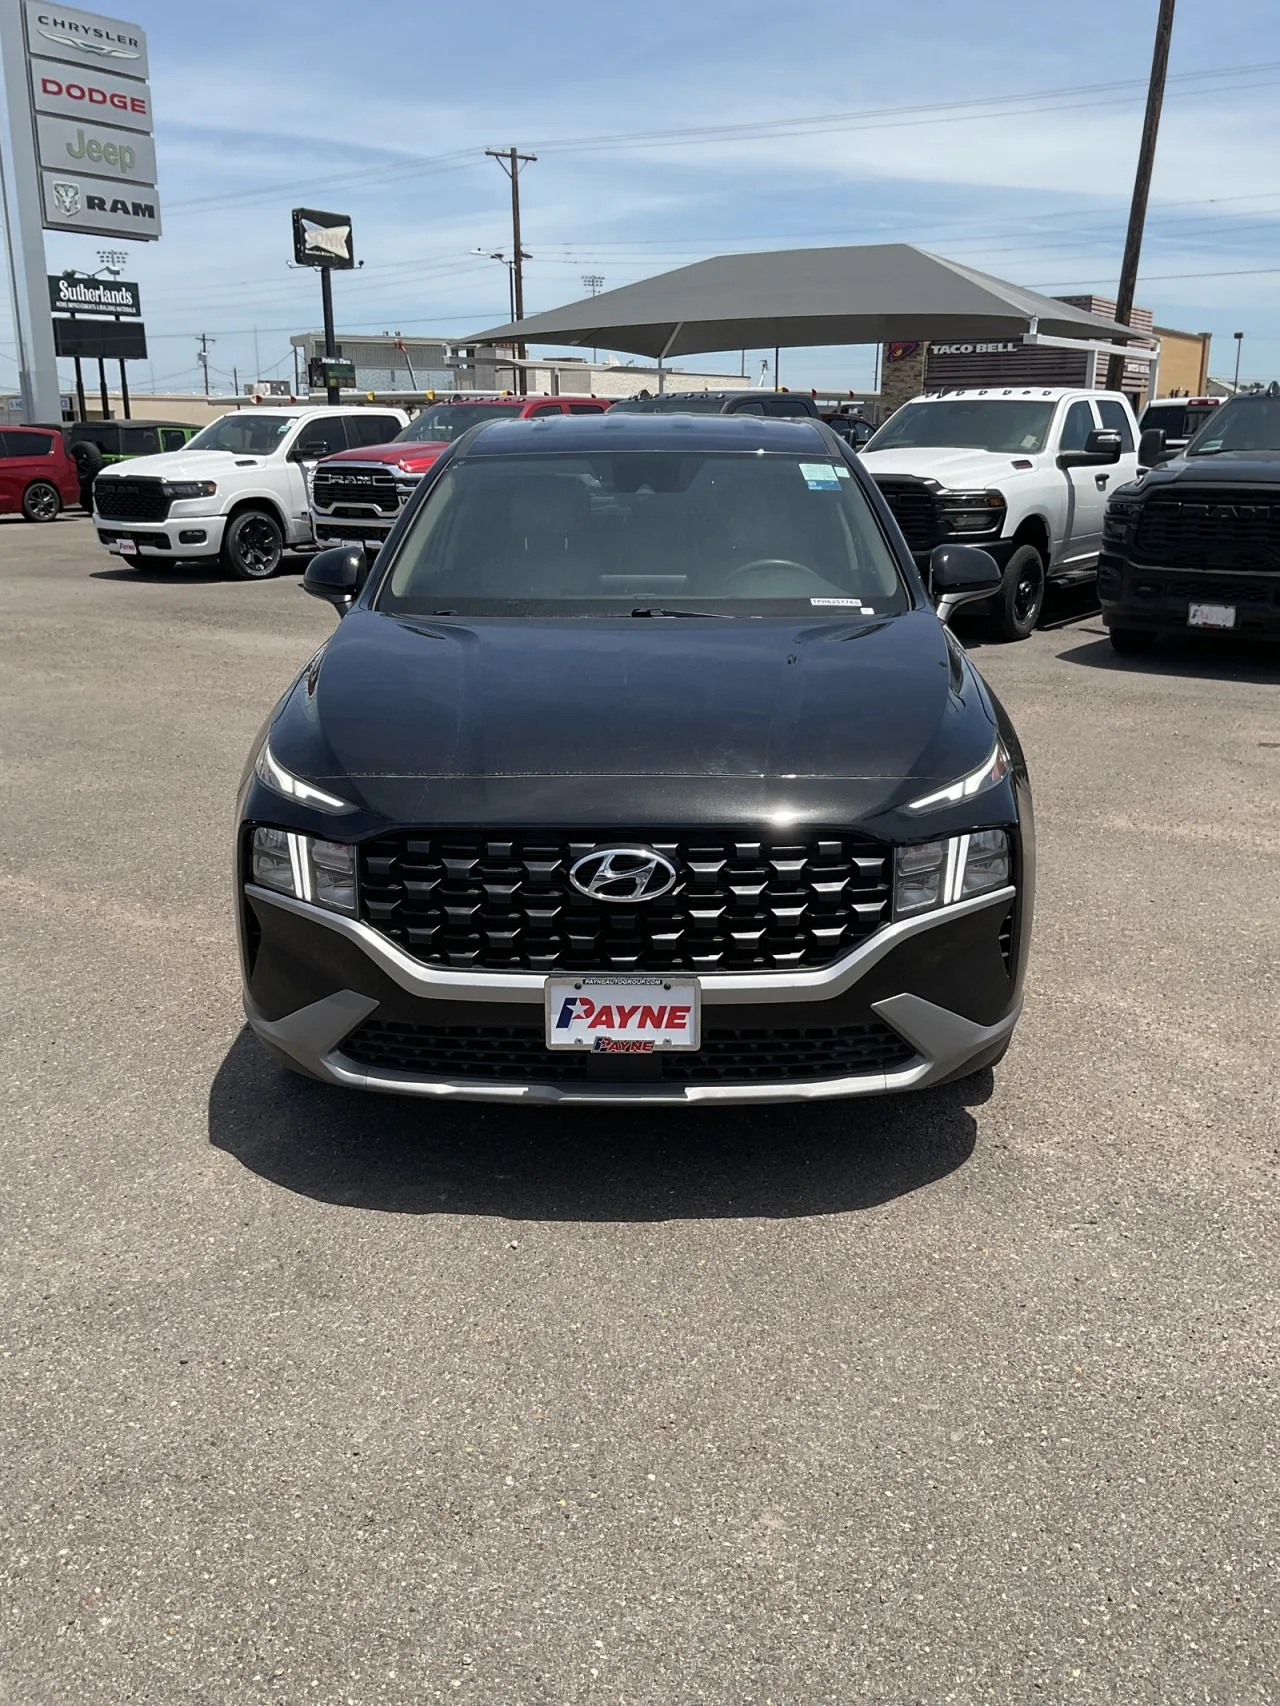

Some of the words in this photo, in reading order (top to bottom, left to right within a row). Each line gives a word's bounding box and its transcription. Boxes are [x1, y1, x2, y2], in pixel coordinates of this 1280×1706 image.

[37, 15, 139, 47] CHRYSLER
[41, 78, 146, 114] DODGE
[66, 128, 136, 174] Jeep
[86, 194, 155, 219] RAM
[59, 280, 133, 305] Sutherlands
[931, 344, 971, 354] TACO
[975, 343, 1018, 353] BELL
[332, 475, 371, 484] RAM
[555, 997, 692, 1029] PAYNE
[594, 1036, 655, 1052] PAYNE
